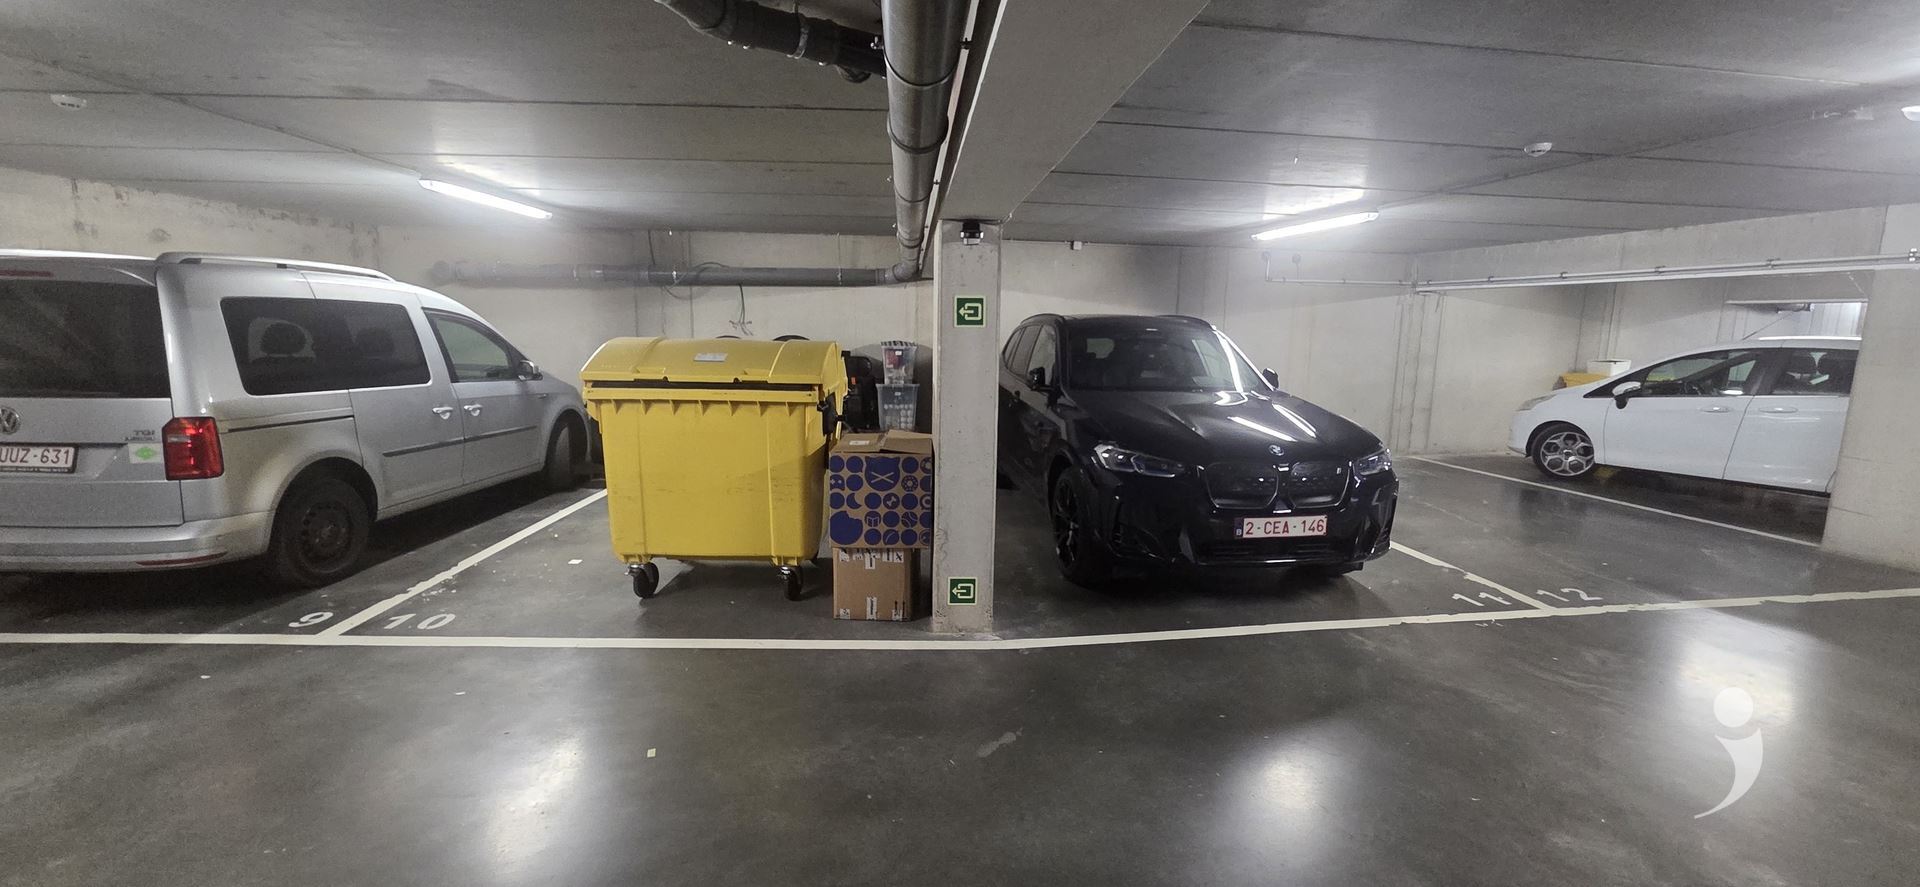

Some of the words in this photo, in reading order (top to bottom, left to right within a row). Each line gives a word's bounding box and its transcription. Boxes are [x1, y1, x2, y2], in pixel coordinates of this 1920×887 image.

[1245, 519, 1325, 535] 2-CEA-146
[1452, 592, 1512, 607] 11
[1537, 588, 1603, 602] 12
[288, 611, 334, 628] 9
[384, 613, 456, 630] 10
